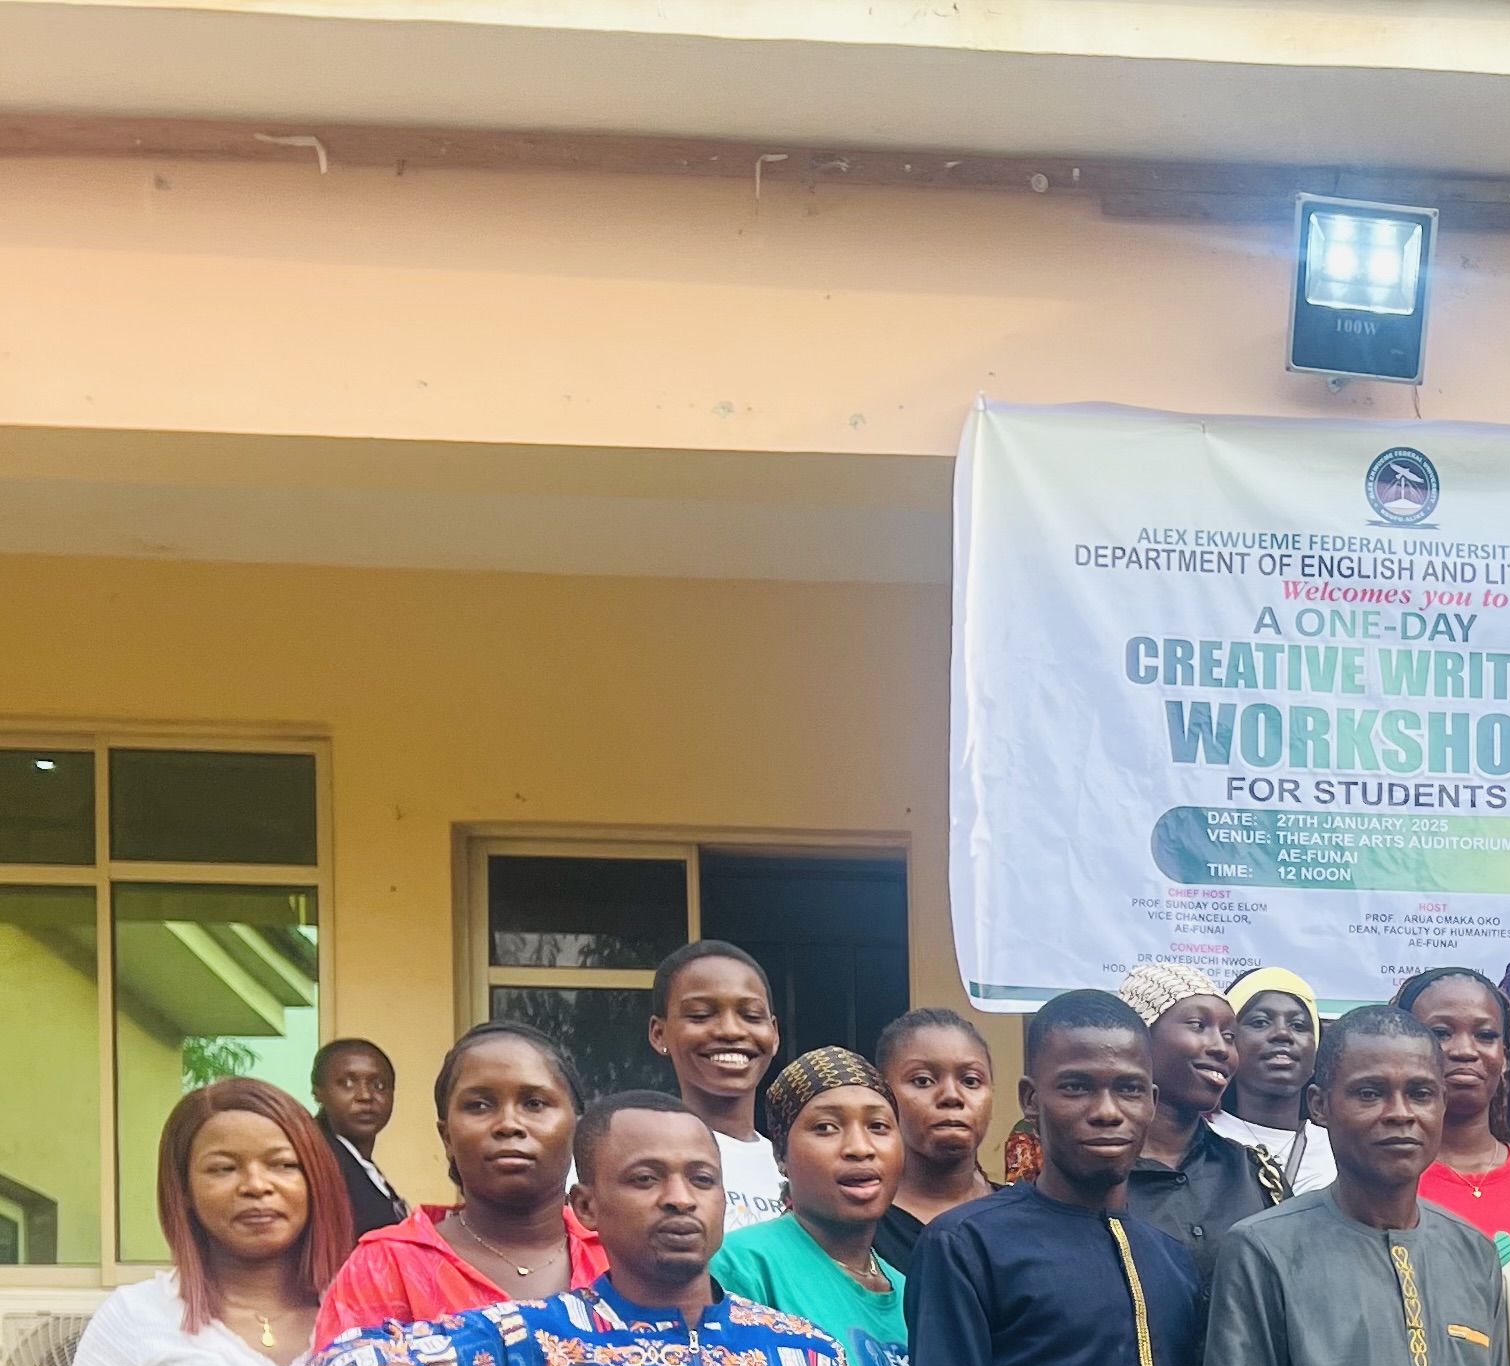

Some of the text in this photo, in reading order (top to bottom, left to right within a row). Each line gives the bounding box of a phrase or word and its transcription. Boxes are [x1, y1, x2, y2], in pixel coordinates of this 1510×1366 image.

[1335, 318, 1378, 336] 100W
[1137, 527, 1188, 546] ALEX
[1195, 530, 1302, 550] EKWUEME
[1309, 534, 1397, 554] FEDERAL
[1075, 544, 1250, 574] DEPARTMENT
[1258, 553, 1292, 576] OF
[1301, 554, 1414, 581] ENGLISH
[1422, 560, 1477, 584] AND
[1282, 580, 1508, 611] Welcomes you to
[1254, 606, 1478, 642] A ONE-DAY
[1126, 637, 1365, 695] CREATIVE
[1227, 776, 1507, 809] FOR STUDENTS
[1208, 812, 1449, 832] DATE: 27TH JANUARY, 2025
[1208, 829, 1271, 844] VENUE:
[1277, 832, 1354, 847] THEATRE
[1359, 834, 1404, 848] ARTS
[1278, 850, 1358, 864] AE-FUNAI
[1208, 863, 1352, 882] TIME: 12 NOON
[1168, 888, 1232, 898] CHIEF HOST
[1166, 901, 1208, 911] SUNDAY
[1212, 902, 1234, 912] OGE
[1238, 902, 1268, 912] ELOM
[1418, 902, 1448, 912] HOST
[1148, 910, 1251, 924] VICE CHANCELLOR,
[1404, 914, 1434, 924] ARUA
[1436, 915, 1474, 926] OMAKA
[1477, 916, 1500, 926] OKO
[1174, 924, 1225, 934] AE-FUNAI
[1348, 924, 1380, 936] DEAN,
[1384, 926, 1430, 936] FACULTY
[1433, 927, 1447, 936] OF
[1170, 942, 1229, 954] CONVENER
[1408, 938, 1458, 948] AE-FUNAI
[1138, 954, 1262, 967] DR ONYEBUCHI NWOSU
[1381, 966, 1395, 974] DR
[1398, 966, 1421, 974] AMA
